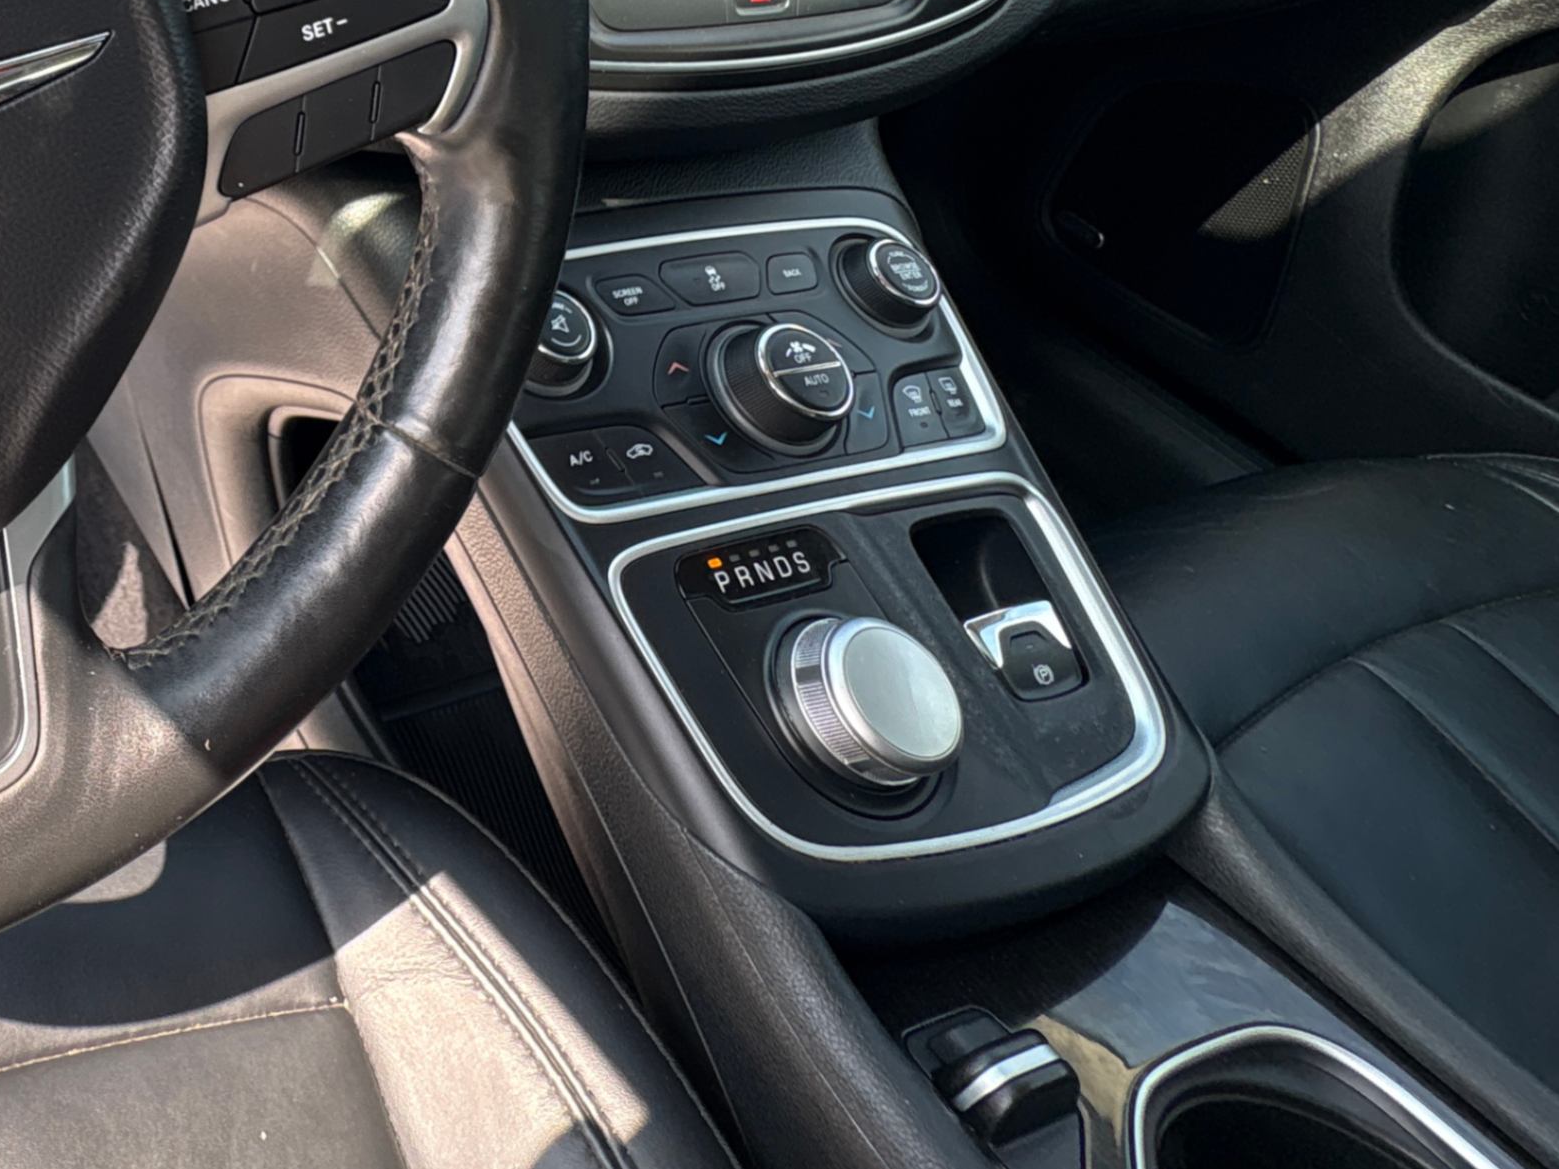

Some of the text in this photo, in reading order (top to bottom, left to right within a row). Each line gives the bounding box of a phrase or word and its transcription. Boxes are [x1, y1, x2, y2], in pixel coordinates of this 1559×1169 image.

[612, 286, 643, 300] SCREEN
[623, 296, 639, 307] OFF
[794, 351, 812, 364] OFF
[804, 373, 830, 386] AUTO
[569, 450, 593, 467] A/C
